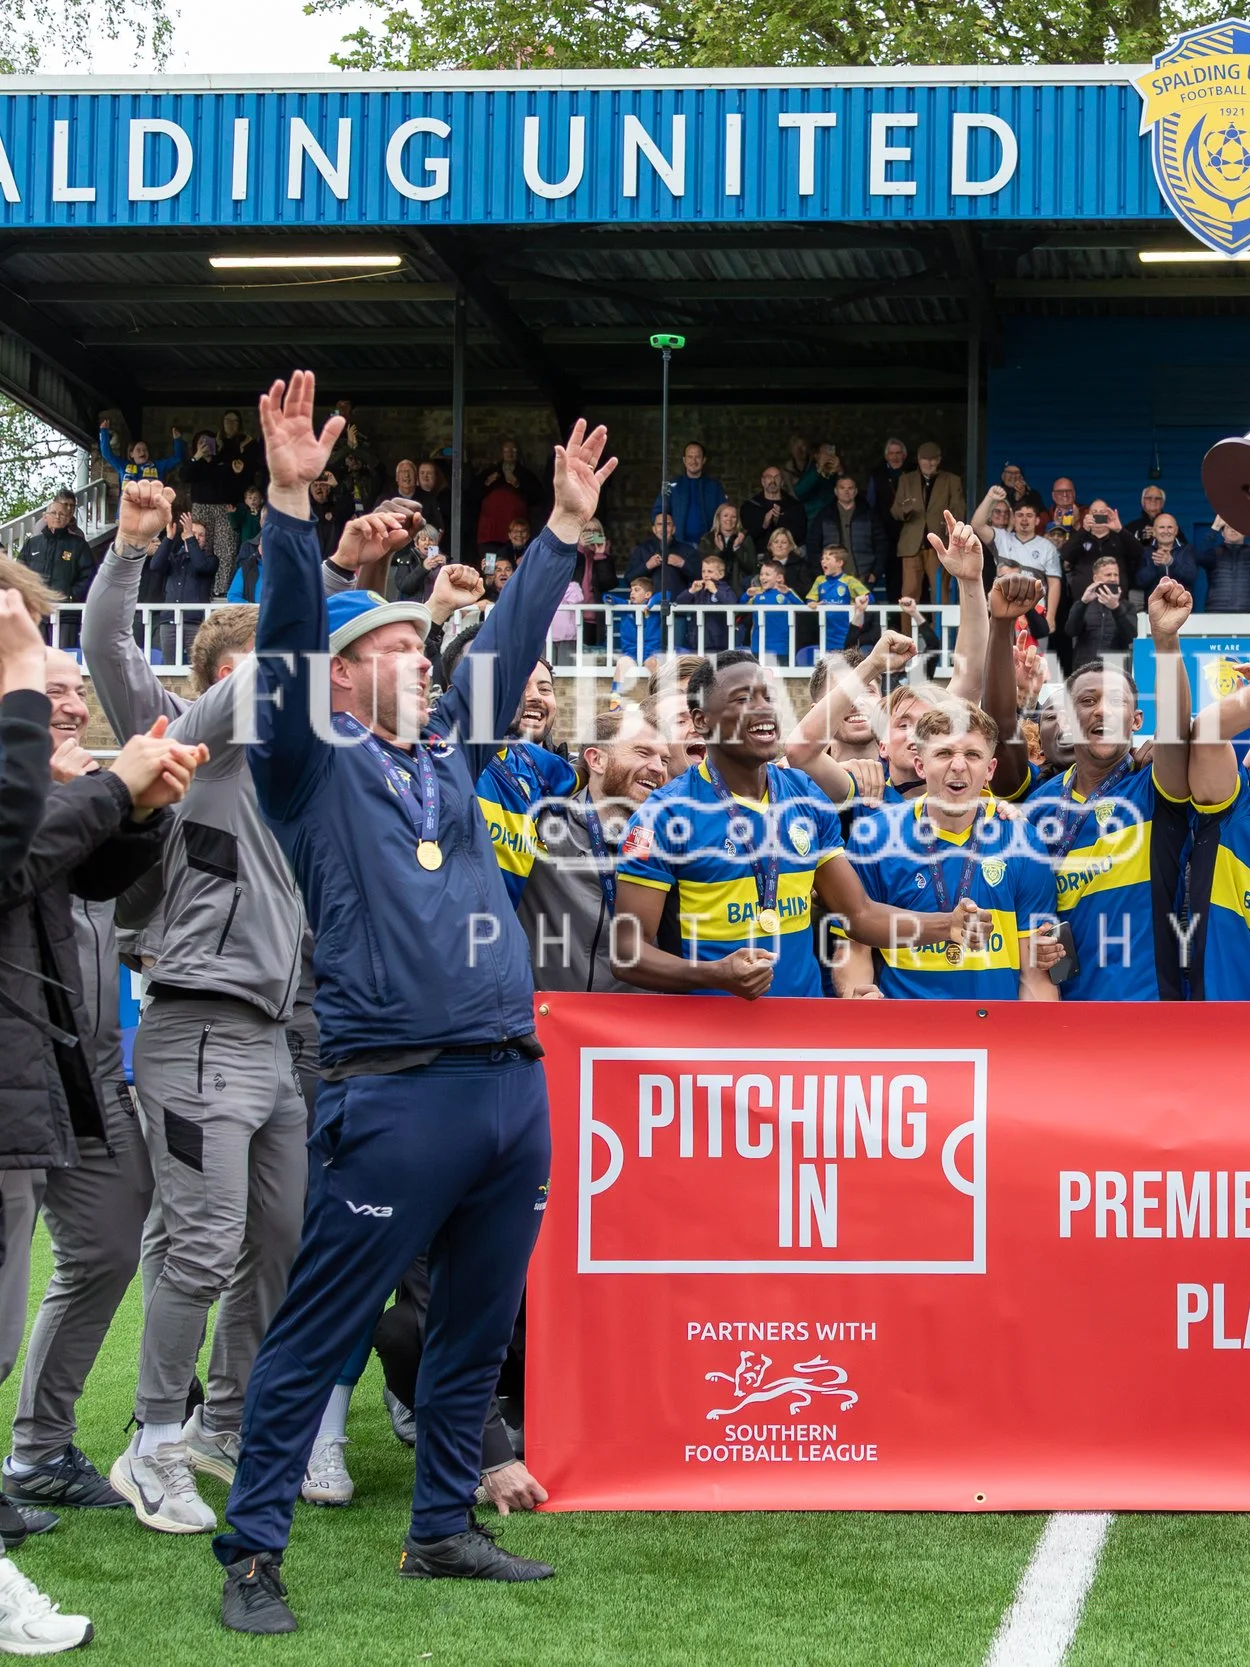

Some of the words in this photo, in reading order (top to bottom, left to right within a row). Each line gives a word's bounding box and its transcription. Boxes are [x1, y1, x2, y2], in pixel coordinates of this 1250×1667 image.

[1152, 63, 1240, 96] SPALDING
[1180, 84, 1246, 103] FOOTBALL
[1219, 107, 1245, 117] 1921
[523, 112, 1019, 200] UNITED
[346, 1200, 394, 1218] VX3
[799, 1163, 838, 1248] IN
[687, 1321, 810, 1341] PARTNERS
[815, 1321, 877, 1341] WITH
[724, 1424, 837, 1442] SOUTHERN
[684, 1444, 793, 1462] FOOTBALL
[798, 1444, 878, 1462] LEAGUE
